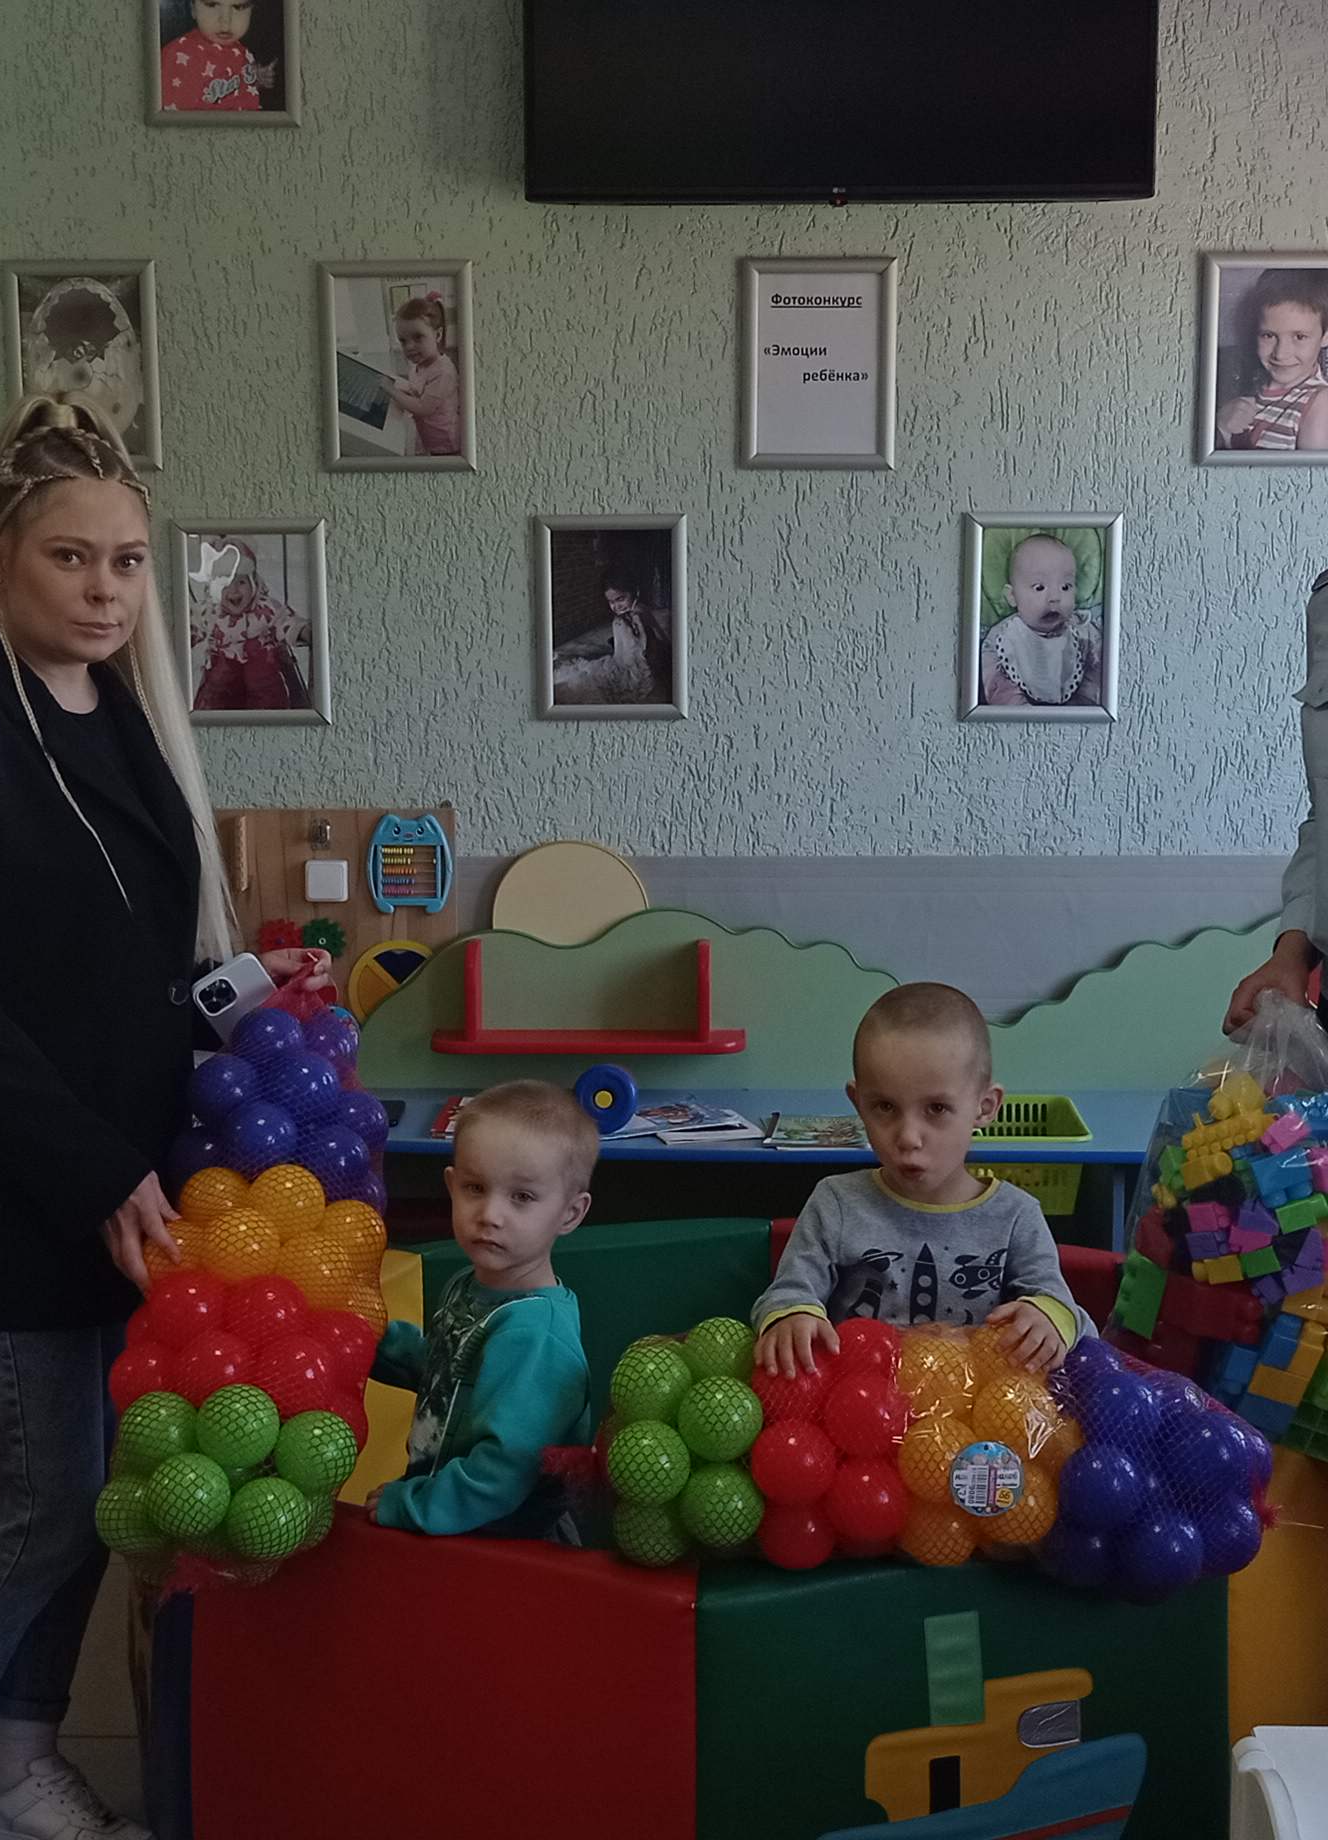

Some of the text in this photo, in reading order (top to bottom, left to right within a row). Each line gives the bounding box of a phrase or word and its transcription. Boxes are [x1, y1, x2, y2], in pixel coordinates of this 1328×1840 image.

[770, 293, 863, 308] Фотоконкурс
[763, 344, 828, 359] «Эмоции
[802, 367, 869, 384] ребёнка»
